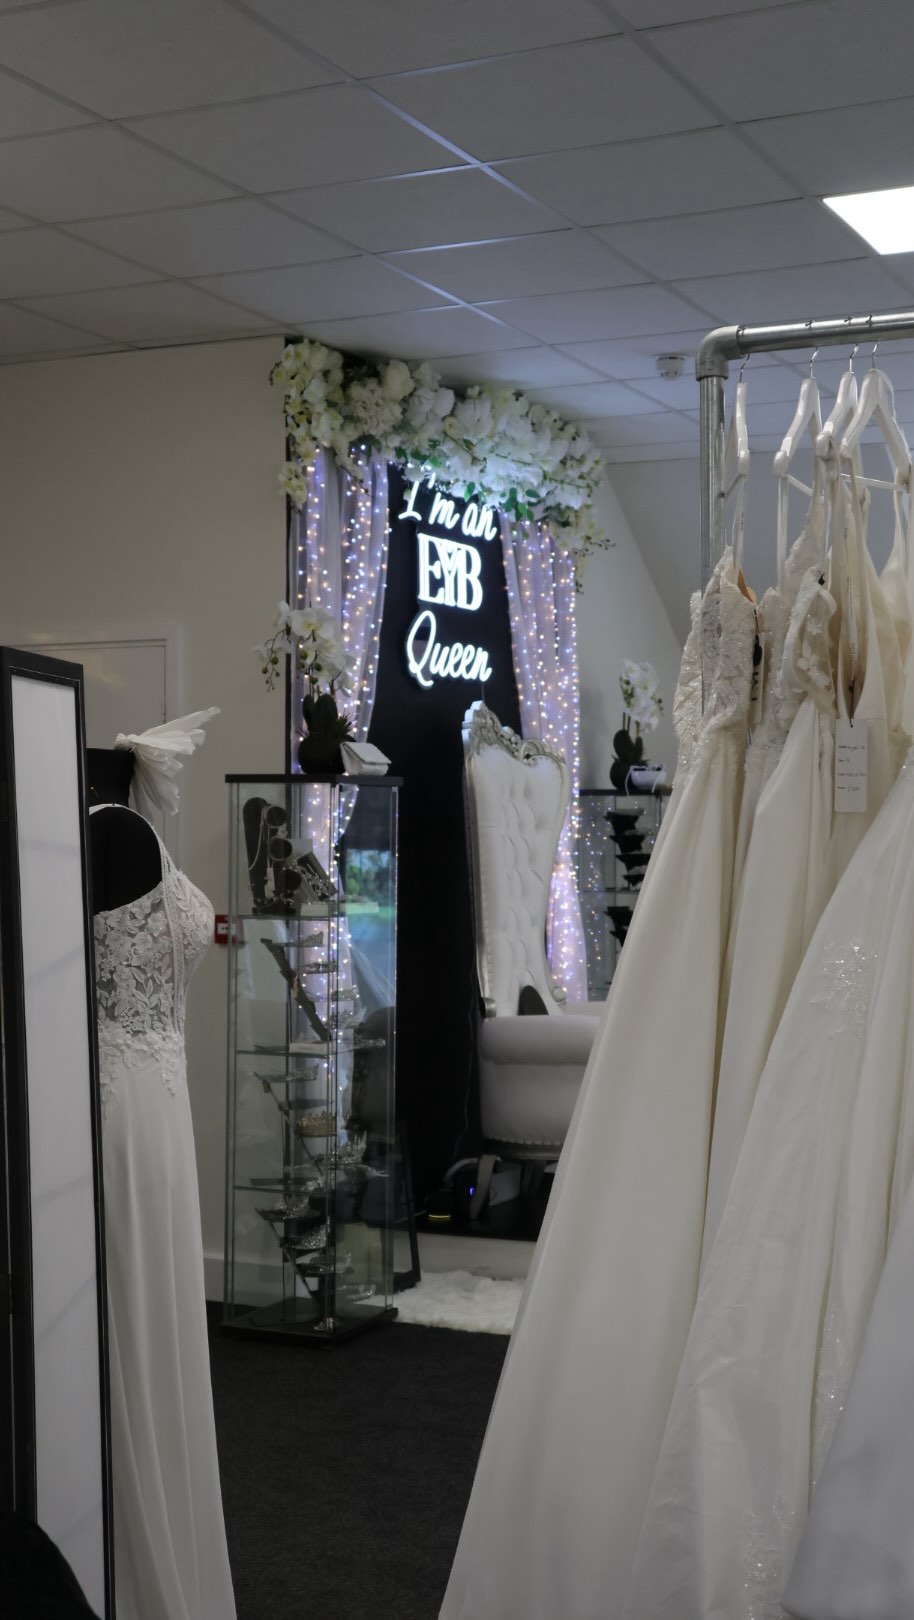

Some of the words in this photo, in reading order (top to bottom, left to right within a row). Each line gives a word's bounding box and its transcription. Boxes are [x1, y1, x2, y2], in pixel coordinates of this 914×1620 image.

[398, 472, 460, 530] I'm
[461, 502, 498, 541] an
[406, 610, 493, 687] Queen
